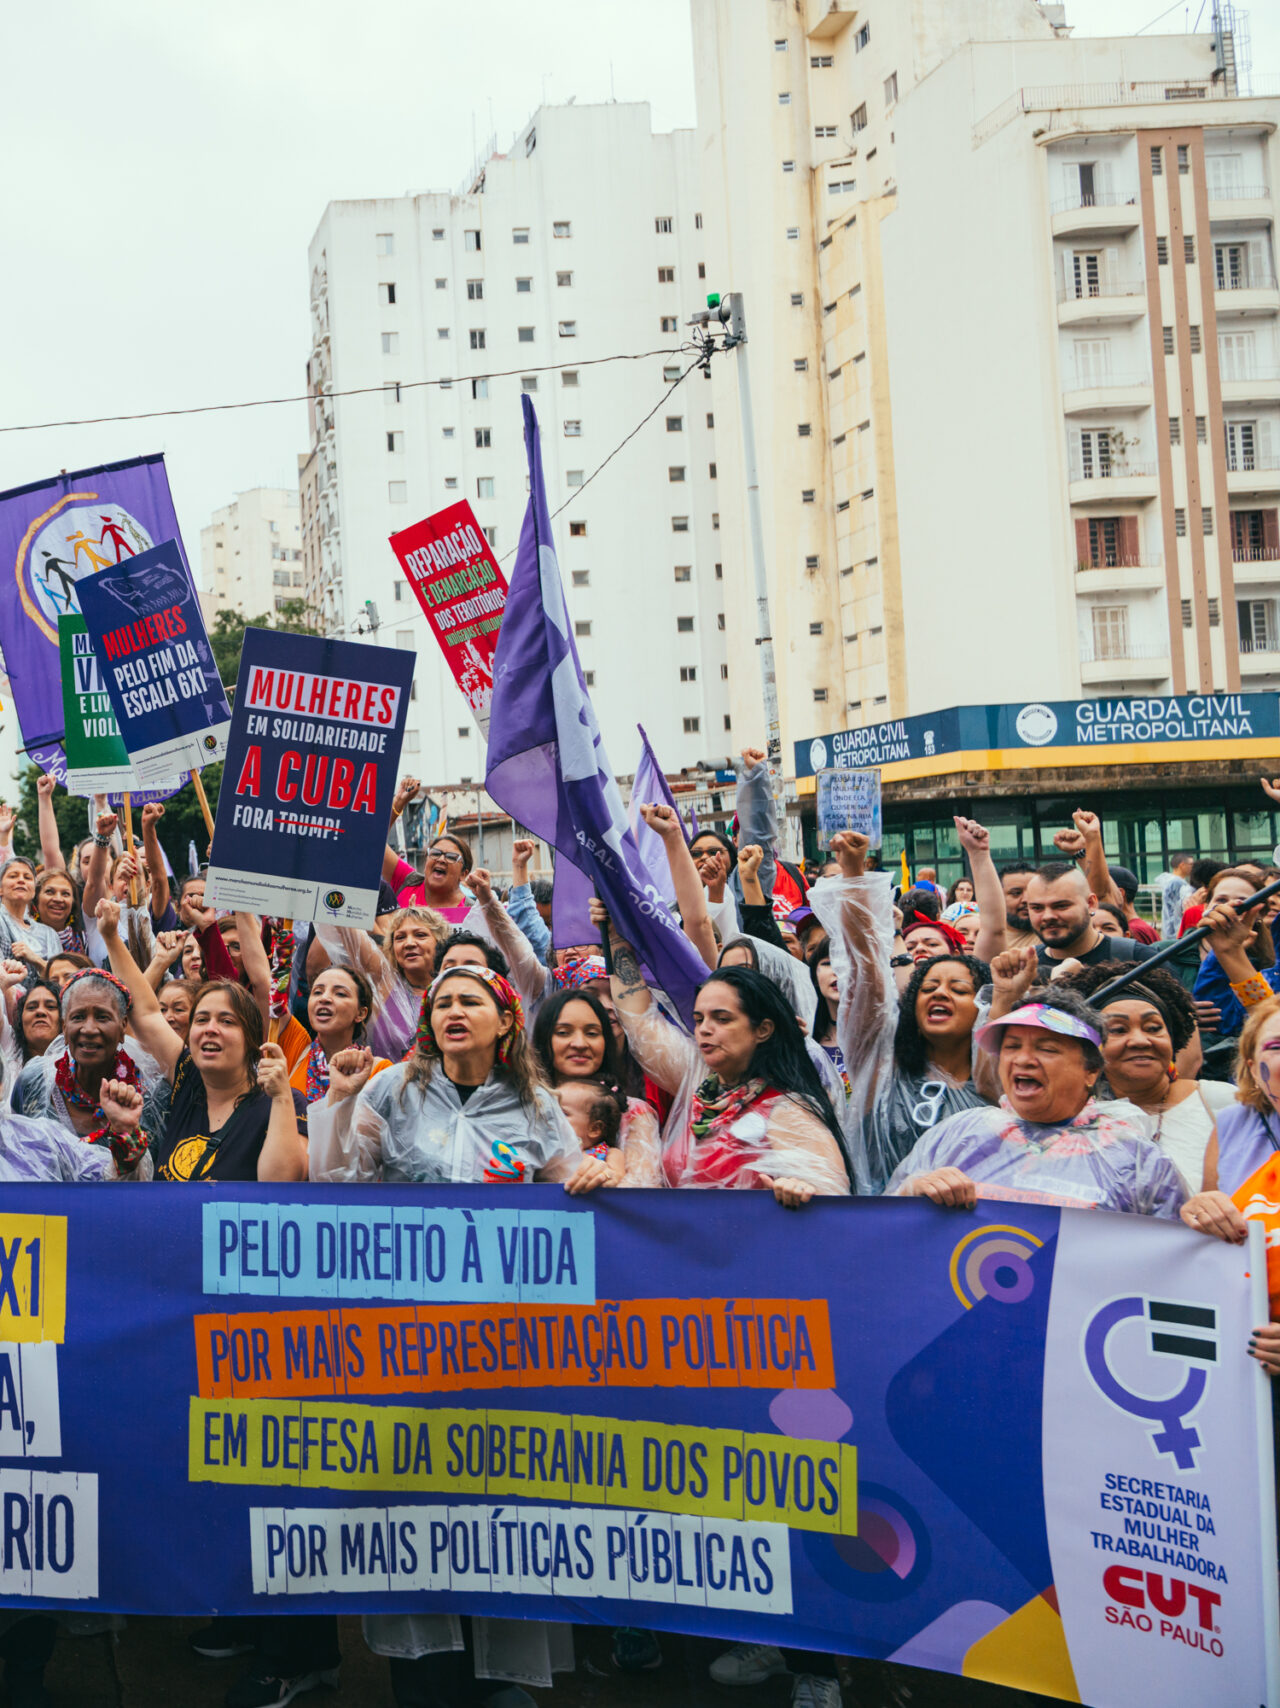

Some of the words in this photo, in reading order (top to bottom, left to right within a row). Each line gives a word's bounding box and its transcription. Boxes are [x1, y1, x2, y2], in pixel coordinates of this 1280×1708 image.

[404, 522, 483, 581] REPARAÇÃO
[420, 583, 435, 608] É
[428, 558, 498, 606] DEMARCAÇÃO
[102, 604, 188, 662] MULHERES
[433, 609, 458, 631] DOS
[451, 587, 507, 628] TERRITÓRIOS
[445, 623, 477, 647] INDÍGENAS
[113, 657, 149, 692] PELO
[147, 647, 177, 679] FIM
[175, 639, 200, 669] DA
[80, 696, 88, 714] E
[122, 677, 180, 719] ESCALA
[177, 666, 208, 699] 6X1
[249, 668, 397, 725] MULHERES
[1075, 698, 1185, 725] GUARDA
[1188, 695, 1251, 719] CIVIL
[246, 714, 269, 738] EM
[271, 717, 388, 754] SOLIDARIEDADE
[832, 727, 878, 752] GUARDA
[878, 721, 909, 743] CIVIL
[833, 741, 911, 768] METROPOLITANA
[924, 743, 936, 755] 153
[1076, 717, 1253, 743] METROPOLITANA
[235, 745, 263, 799] A
[275, 750, 379, 815] CUBA
[233, 804, 274, 832] FORA
[278, 811, 342, 841] TRUMP!
[219, 1219, 301, 1279] PELO
[317, 1221, 446, 1283] DIREITO
[461, 1210, 484, 1284] À
[497, 1225, 578, 1286] VIDA
[210, 1327, 272, 1383] POR
[283, 1323, 365, 1380] MAIS
[378, 1302, 649, 1383] REPRESENTAÇÃO
[660, 1300, 817, 1372] POLÍTICA
[203, 1411, 248, 1468] EM
[261, 1414, 380, 1474] DEFESA
[393, 1421, 433, 1475] DA
[446, 1422, 628, 1489] SOBERANIA
[643, 1436, 709, 1499] DOS
[723, 1445, 839, 1516] POVOS
[1100, 1492, 1192, 1529] ESTADUAL
[1196, 1511, 1216, 1536] DA
[1104, 1472, 1211, 1513] SECRETARIA
[266, 1522, 328, 1579] POR
[340, 1520, 418, 1576] MAIS
[430, 1507, 595, 1581] POLÍTICAS
[606, 1514, 774, 1596] PÚBLICAS
[1090, 1531, 1228, 1584] TRABALHADORA
[1124, 1517, 1200, 1553] MULHER
[1102, 1564, 1222, 1631] CUT
[1104, 1605, 1153, 1633] SÃO
[1160, 1622, 1225, 1658] PAULO
